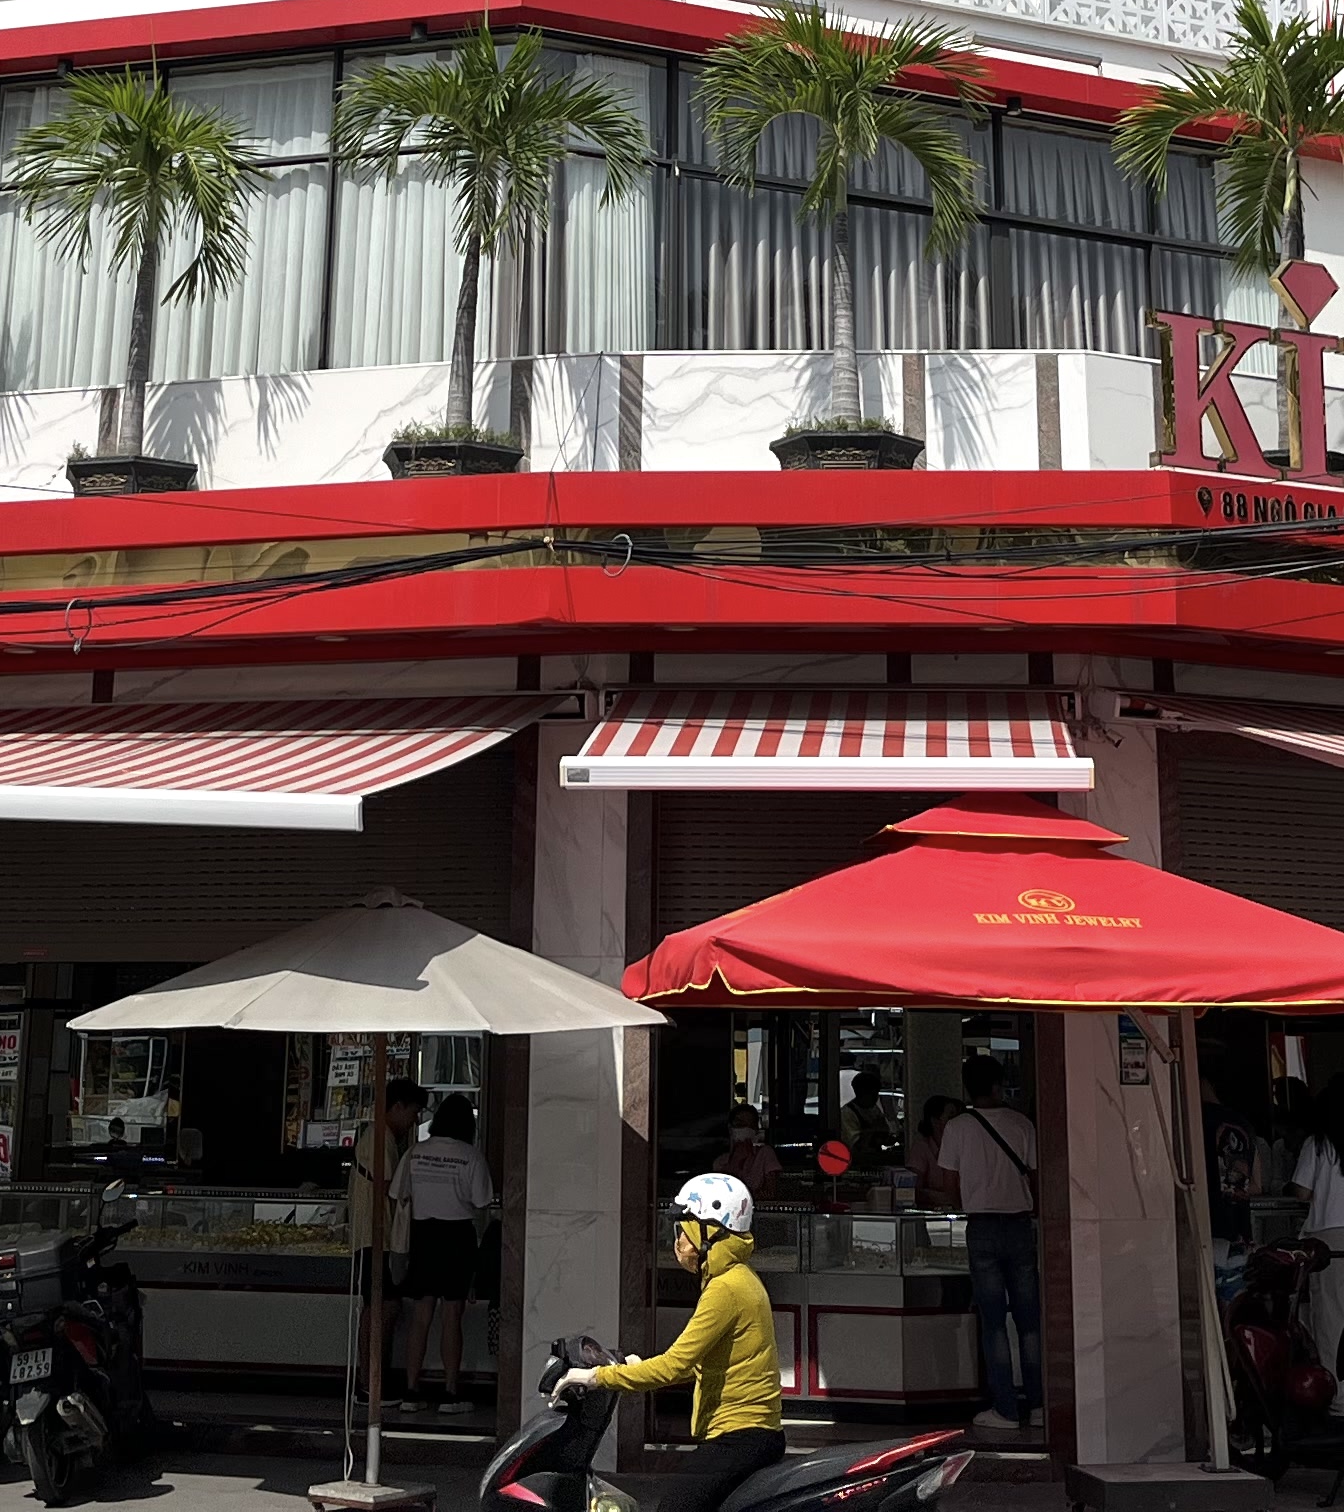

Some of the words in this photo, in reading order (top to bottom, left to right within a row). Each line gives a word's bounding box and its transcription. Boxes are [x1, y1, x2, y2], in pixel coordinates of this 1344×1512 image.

[1221, 490, 1249, 522] 88
[1253, 495, 1298, 525] NGÔ
[973, 912, 1013, 925] KIM
[1012, 913, 1061, 926] VINH
[1063, 915, 1143, 929] JEWELRY
[182, 1261, 210, 1274] KIM
[214, 1261, 249, 1275] VINH
